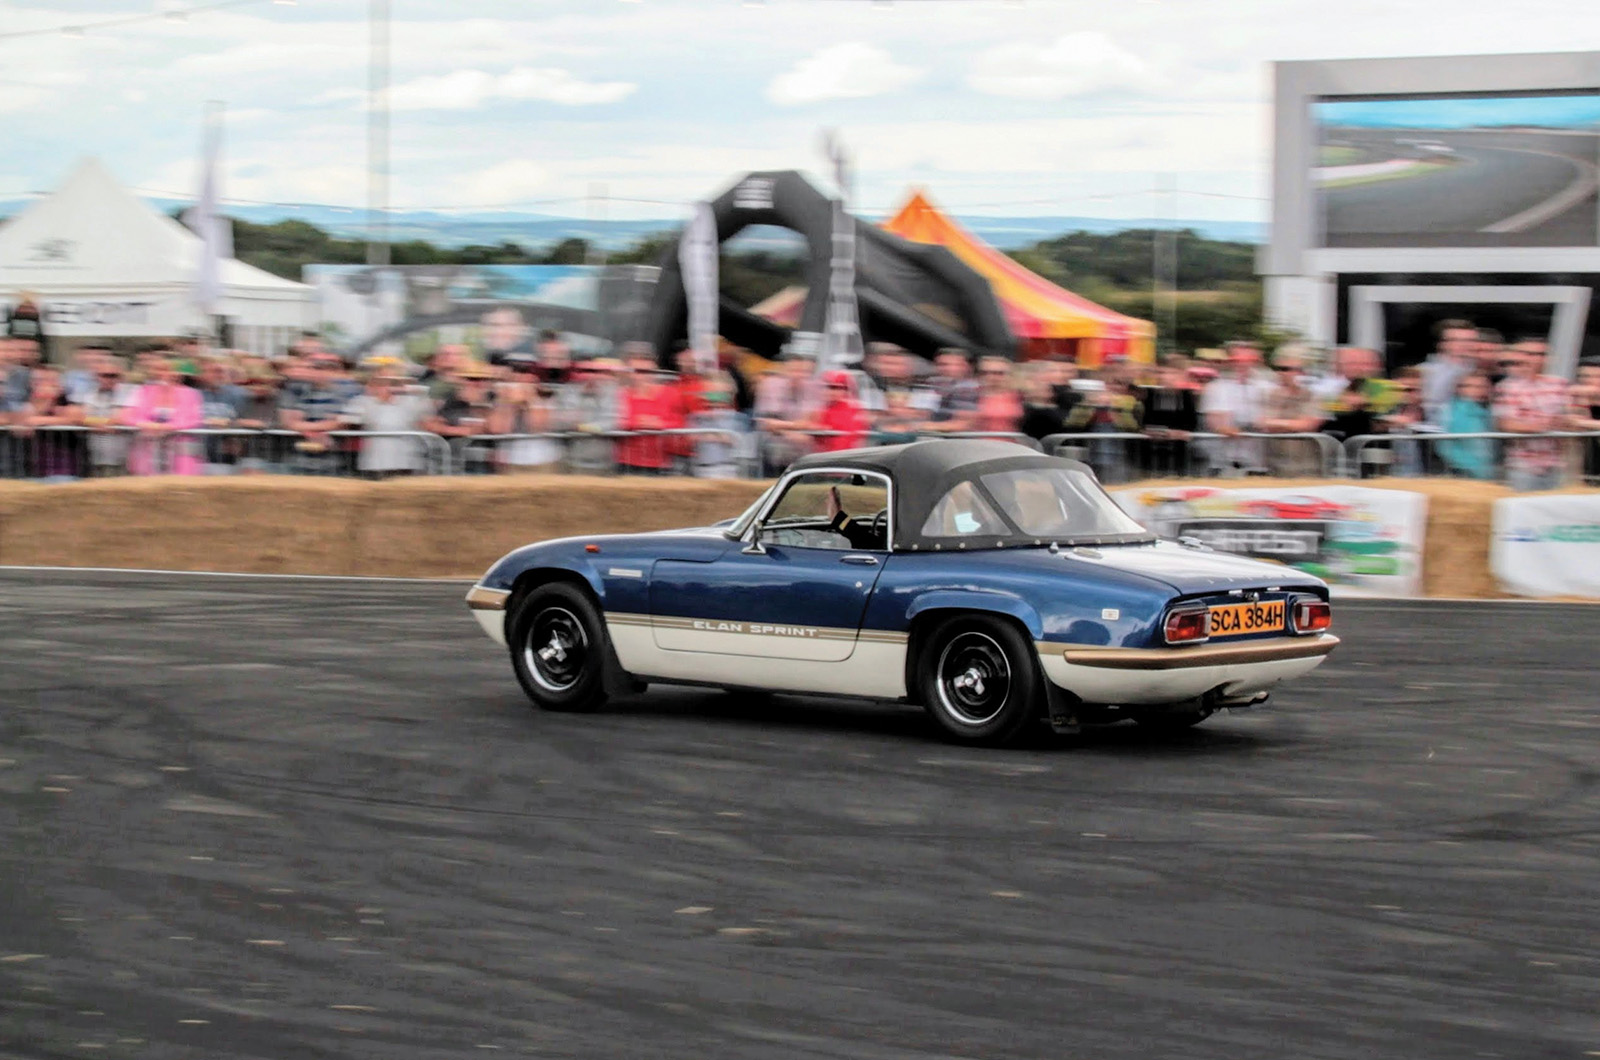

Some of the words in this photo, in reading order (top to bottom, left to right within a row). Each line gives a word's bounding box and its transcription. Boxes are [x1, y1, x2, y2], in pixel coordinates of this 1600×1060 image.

[693, 621, 742, 632] ELAN
[750, 625, 817, 637] SPRINT
[1211, 609, 1240, 632] SCA
[1245, 605, 1283, 629] 384H
